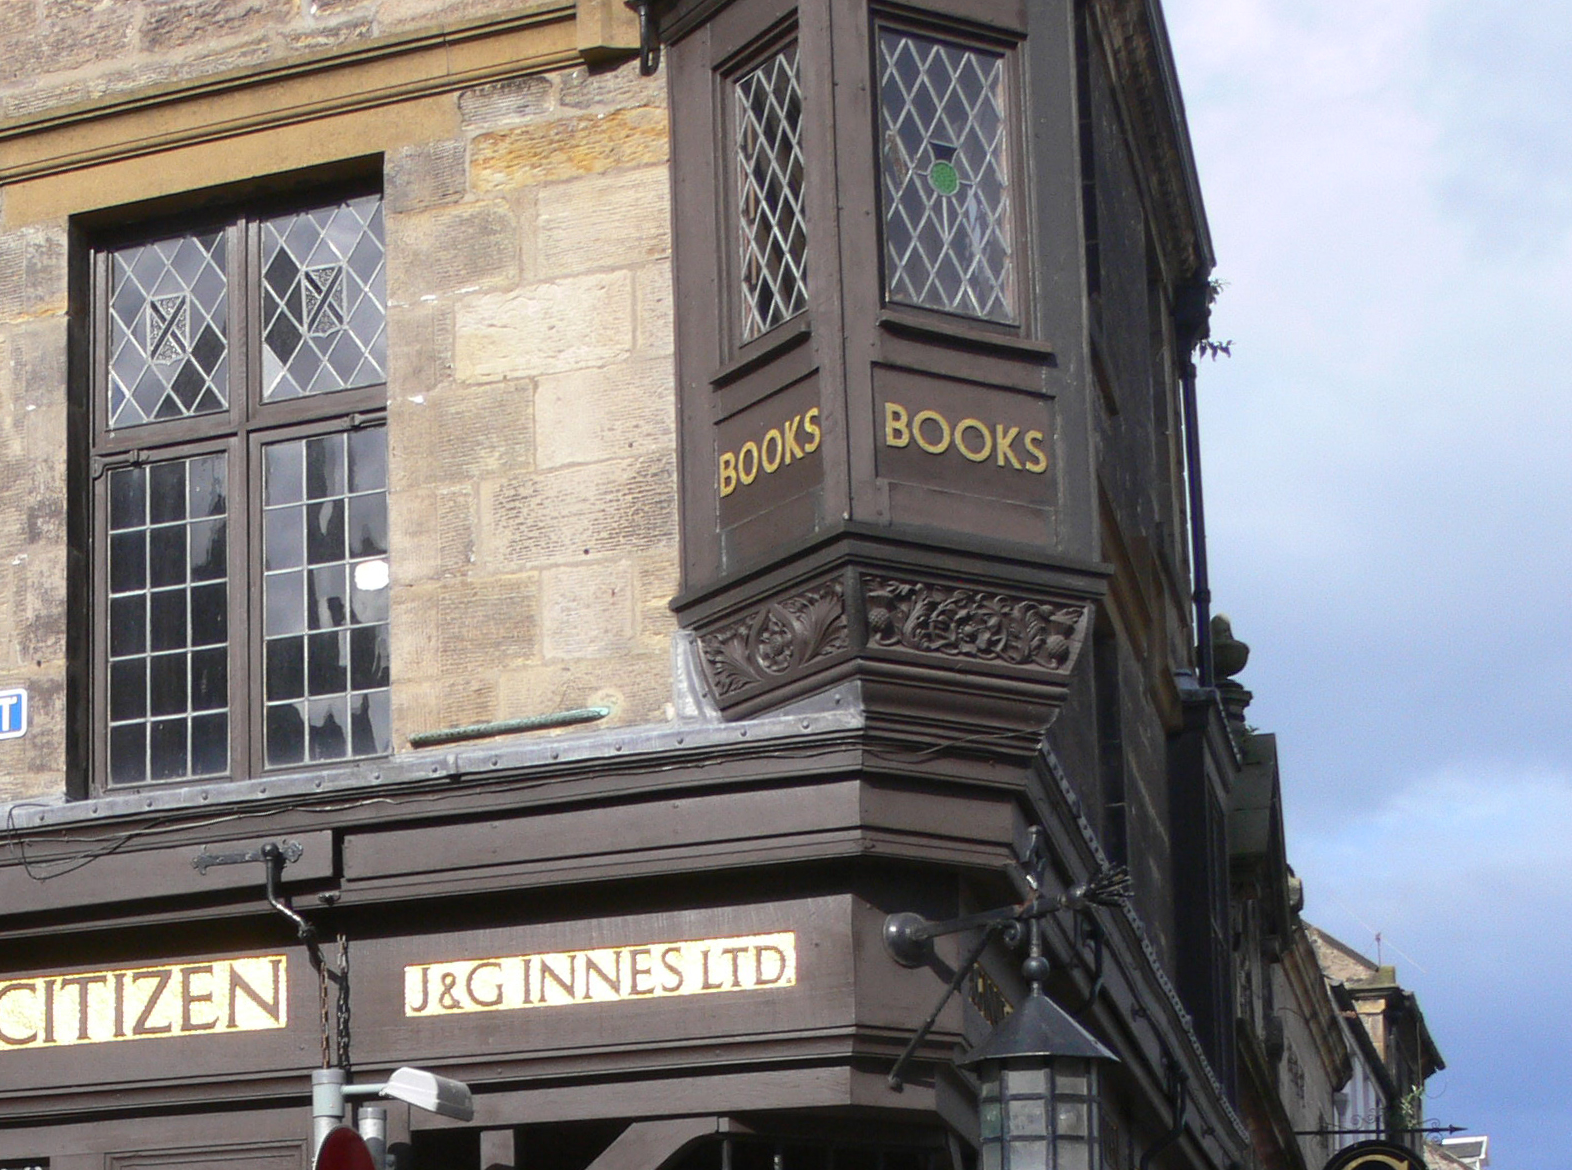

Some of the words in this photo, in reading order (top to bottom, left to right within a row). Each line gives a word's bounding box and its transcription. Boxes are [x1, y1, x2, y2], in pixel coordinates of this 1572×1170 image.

[719, 406, 822, 498] BOOKS
[885, 402, 1048, 474] BOOKS
[522, 947, 684, 1006] INNES
